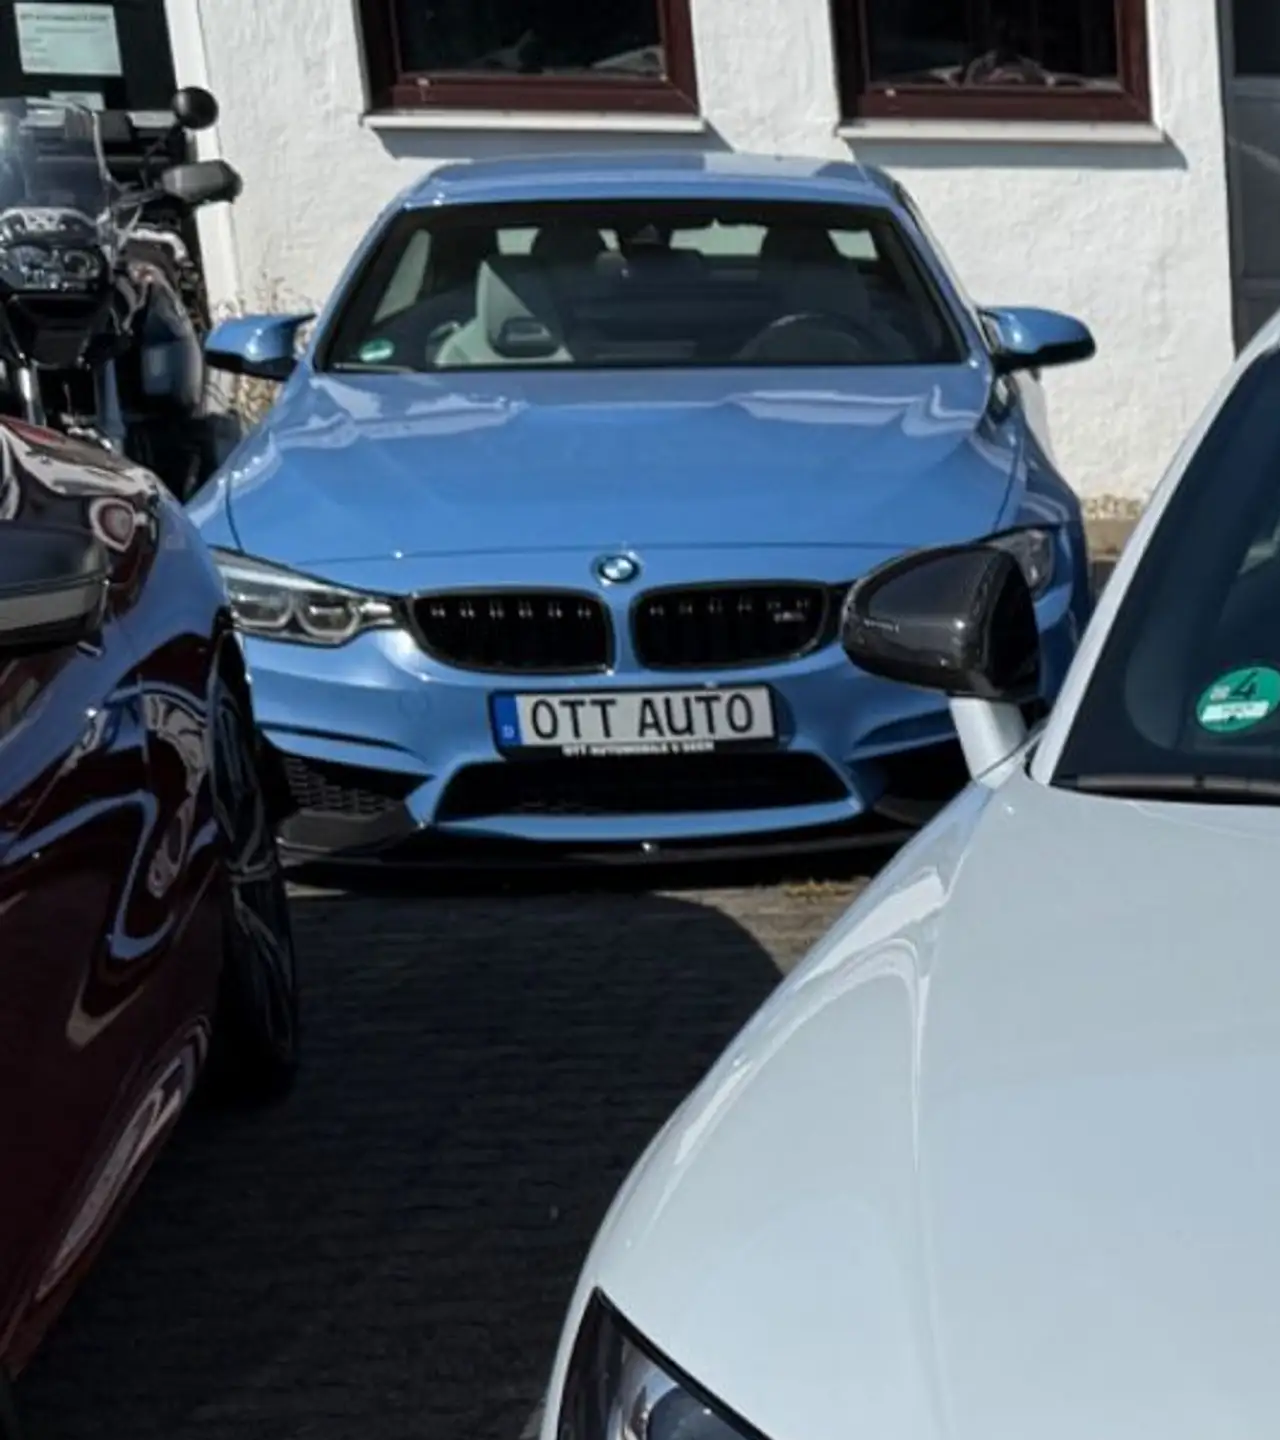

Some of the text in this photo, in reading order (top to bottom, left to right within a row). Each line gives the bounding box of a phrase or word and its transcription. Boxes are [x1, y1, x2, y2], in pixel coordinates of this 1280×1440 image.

[1231, 671, 1258, 700] 4
[530, 691, 755, 740] OTT AUTO
